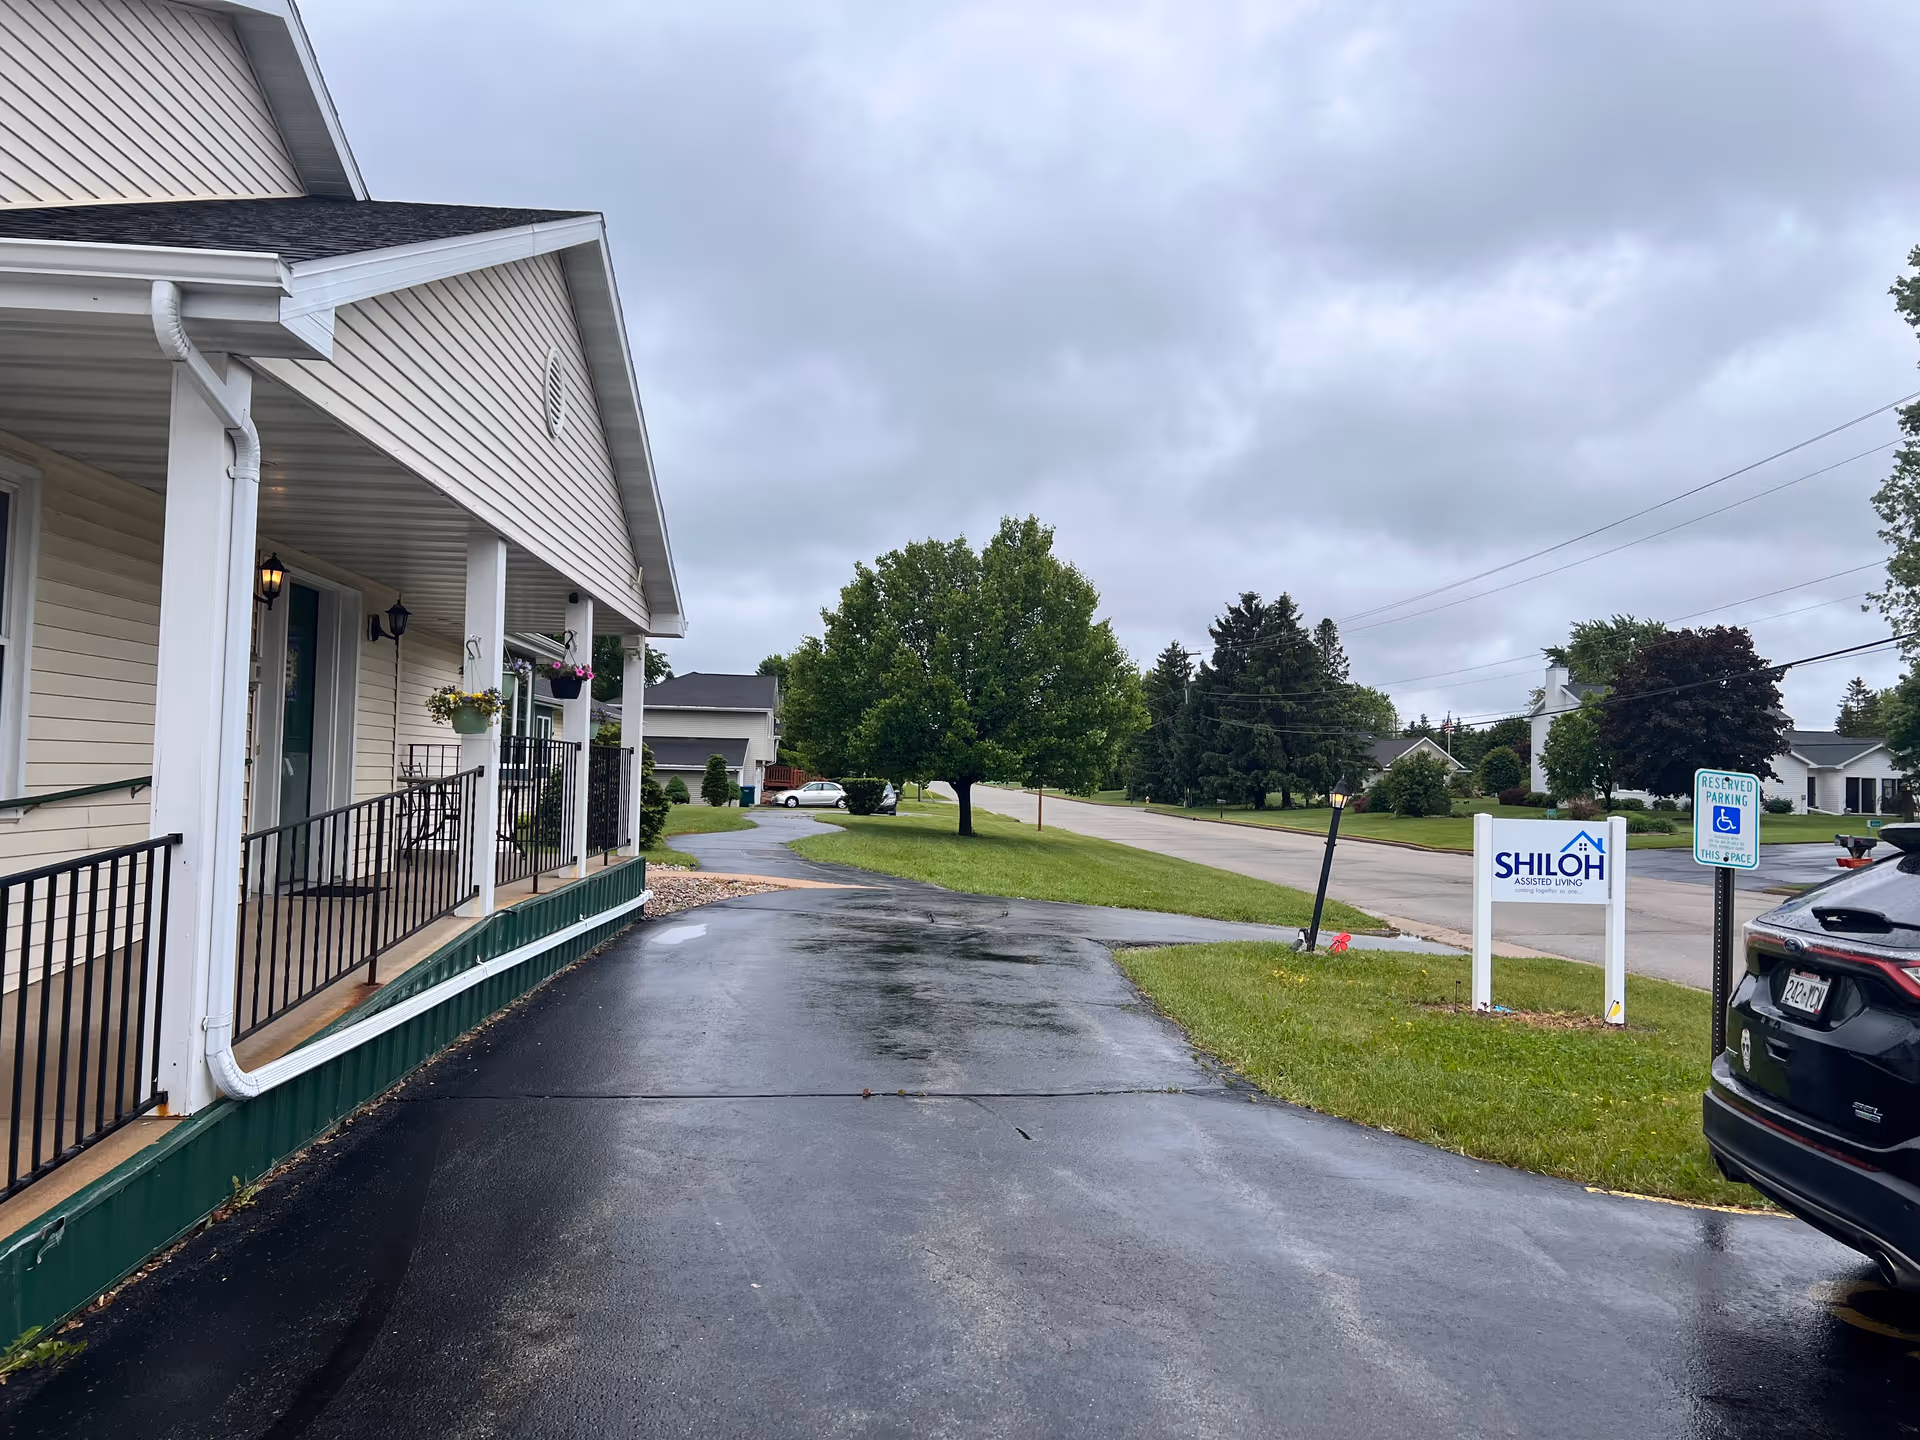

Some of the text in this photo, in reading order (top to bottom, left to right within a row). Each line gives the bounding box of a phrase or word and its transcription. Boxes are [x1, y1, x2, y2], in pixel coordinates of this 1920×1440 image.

[1701, 776, 1753, 793] RESERVED
[1706, 791, 1748, 807] PARKING
[1701, 849, 1752, 864] THIS SPACE
[1494, 852, 1605, 880] SHILOH
[1514, 877, 1583, 887] ASSISTED LIVING
